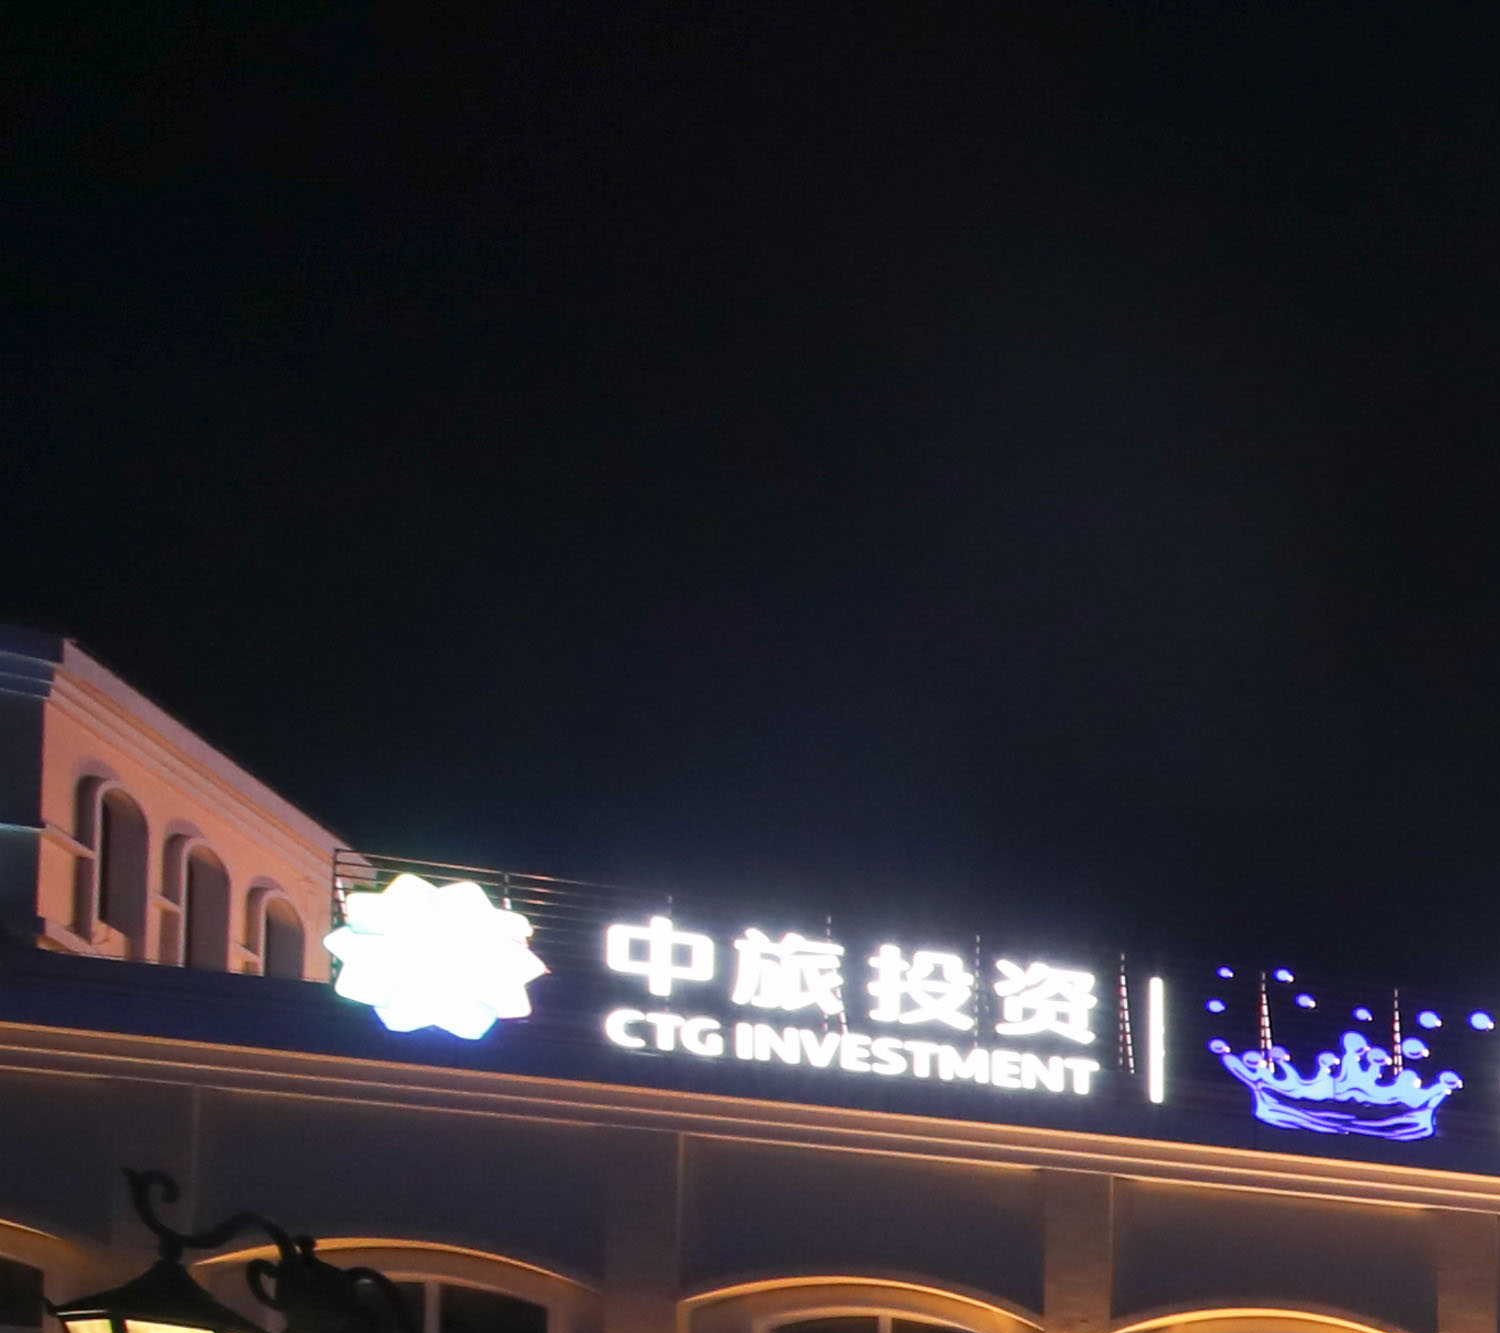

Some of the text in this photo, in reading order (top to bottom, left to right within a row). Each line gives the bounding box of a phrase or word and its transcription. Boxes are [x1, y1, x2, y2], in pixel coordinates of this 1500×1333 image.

[606, 915, 1098, 1045] 中旅投资
[605, 1009, 1100, 1095] CTG INVESTMENT
